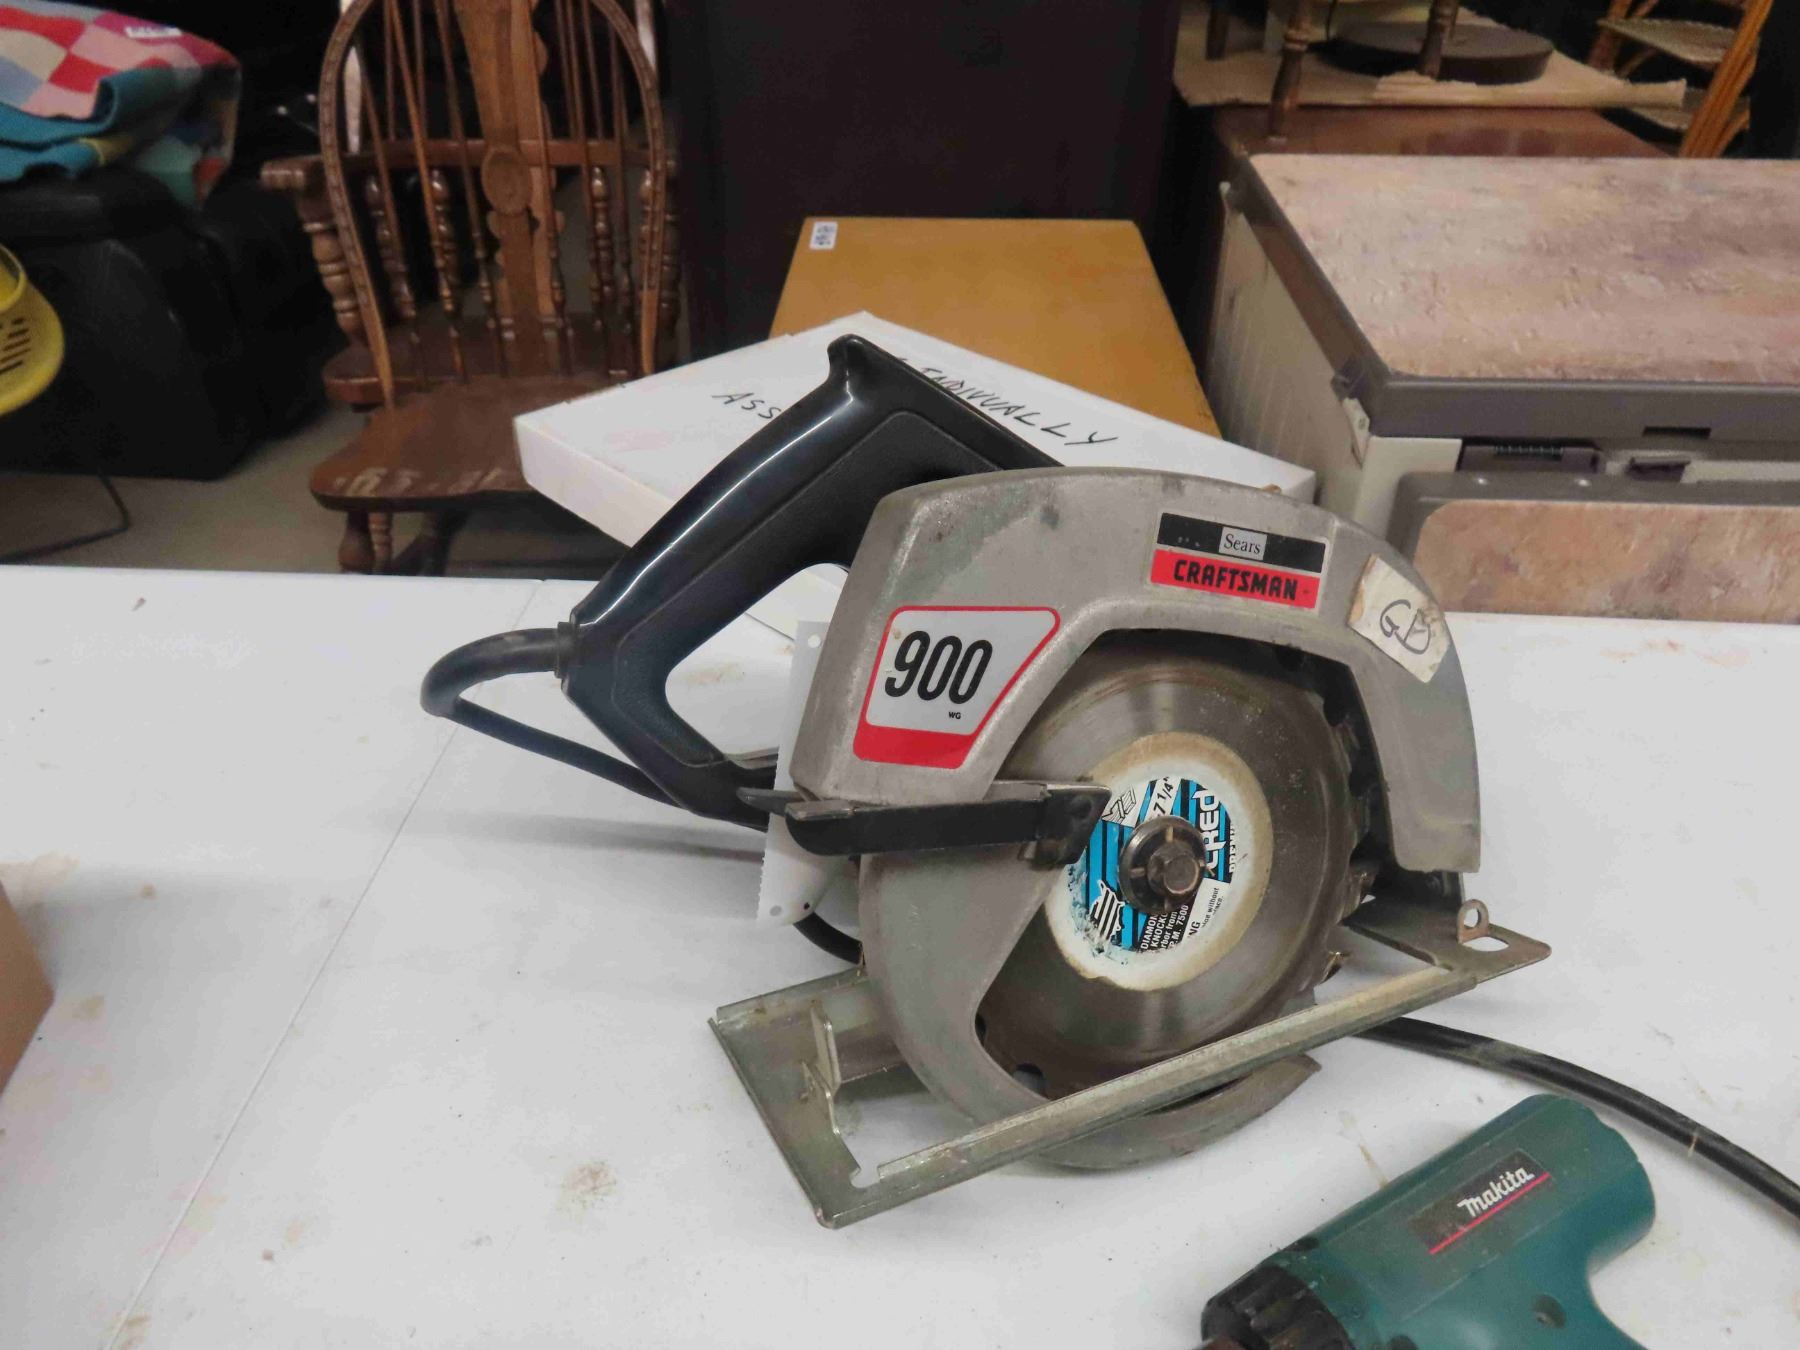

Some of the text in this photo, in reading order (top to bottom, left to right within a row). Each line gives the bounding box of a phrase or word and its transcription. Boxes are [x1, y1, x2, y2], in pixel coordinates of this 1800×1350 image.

[1223, 533, 1261, 556] Sears
[1173, 559, 1298, 601] CRAFTSMAN
[885, 630, 993, 704] 900
[948, 711, 961, 720] WG
[1176, 904, 1189, 926] 7500
